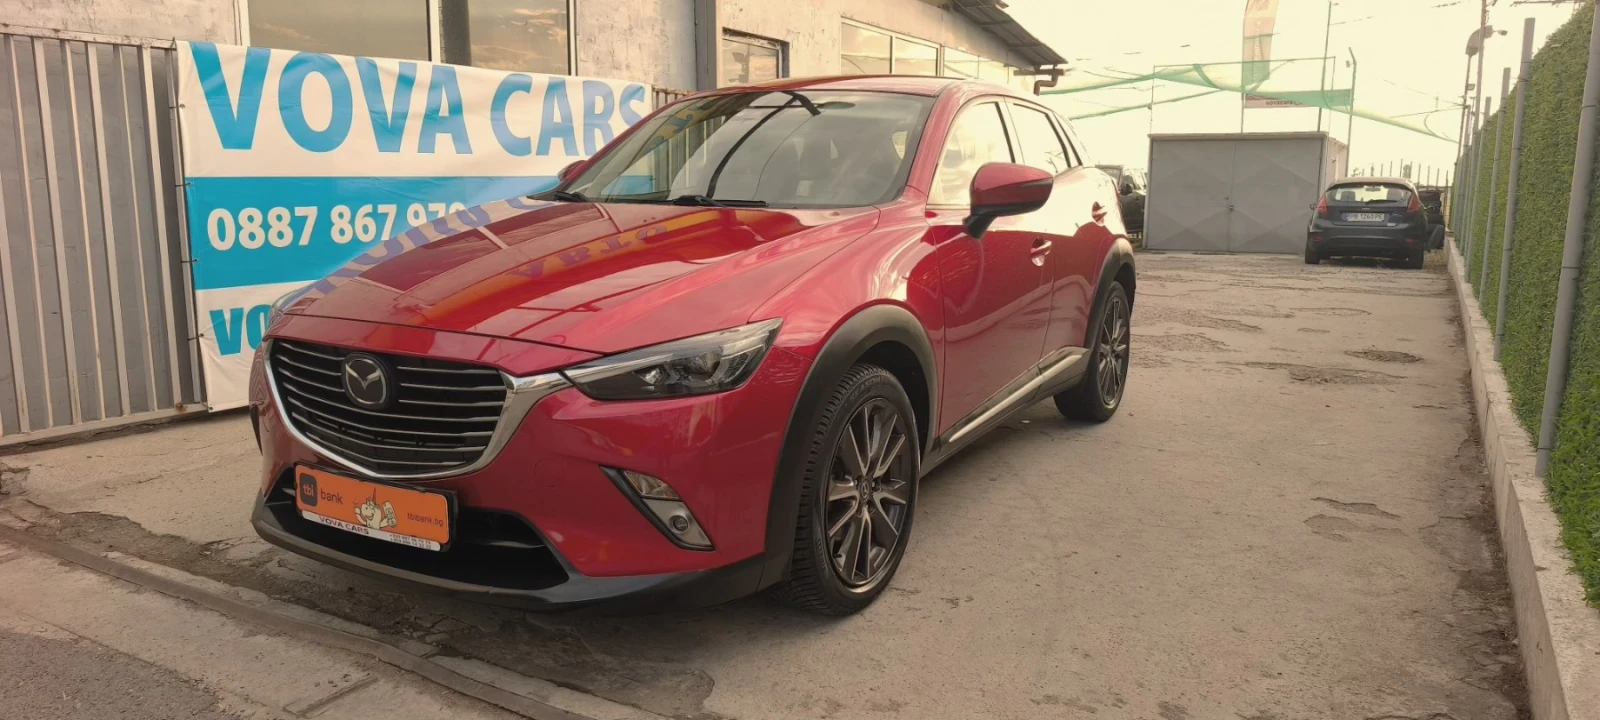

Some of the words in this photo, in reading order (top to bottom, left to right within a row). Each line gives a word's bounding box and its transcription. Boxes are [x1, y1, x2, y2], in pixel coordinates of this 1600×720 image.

[189, 41, 474, 155] VOVA
[490, 73, 646, 157] CARS
[206, 206, 319, 251] 0887
[330, 203, 397, 244] 867
[302, 483, 315, 497] tbi
[320, 488, 344, 505] bank
[319, 516, 344, 529] VOVA
[345, 523, 369, 535] CARS
[407, 512, 444, 527] tbibank.bg
